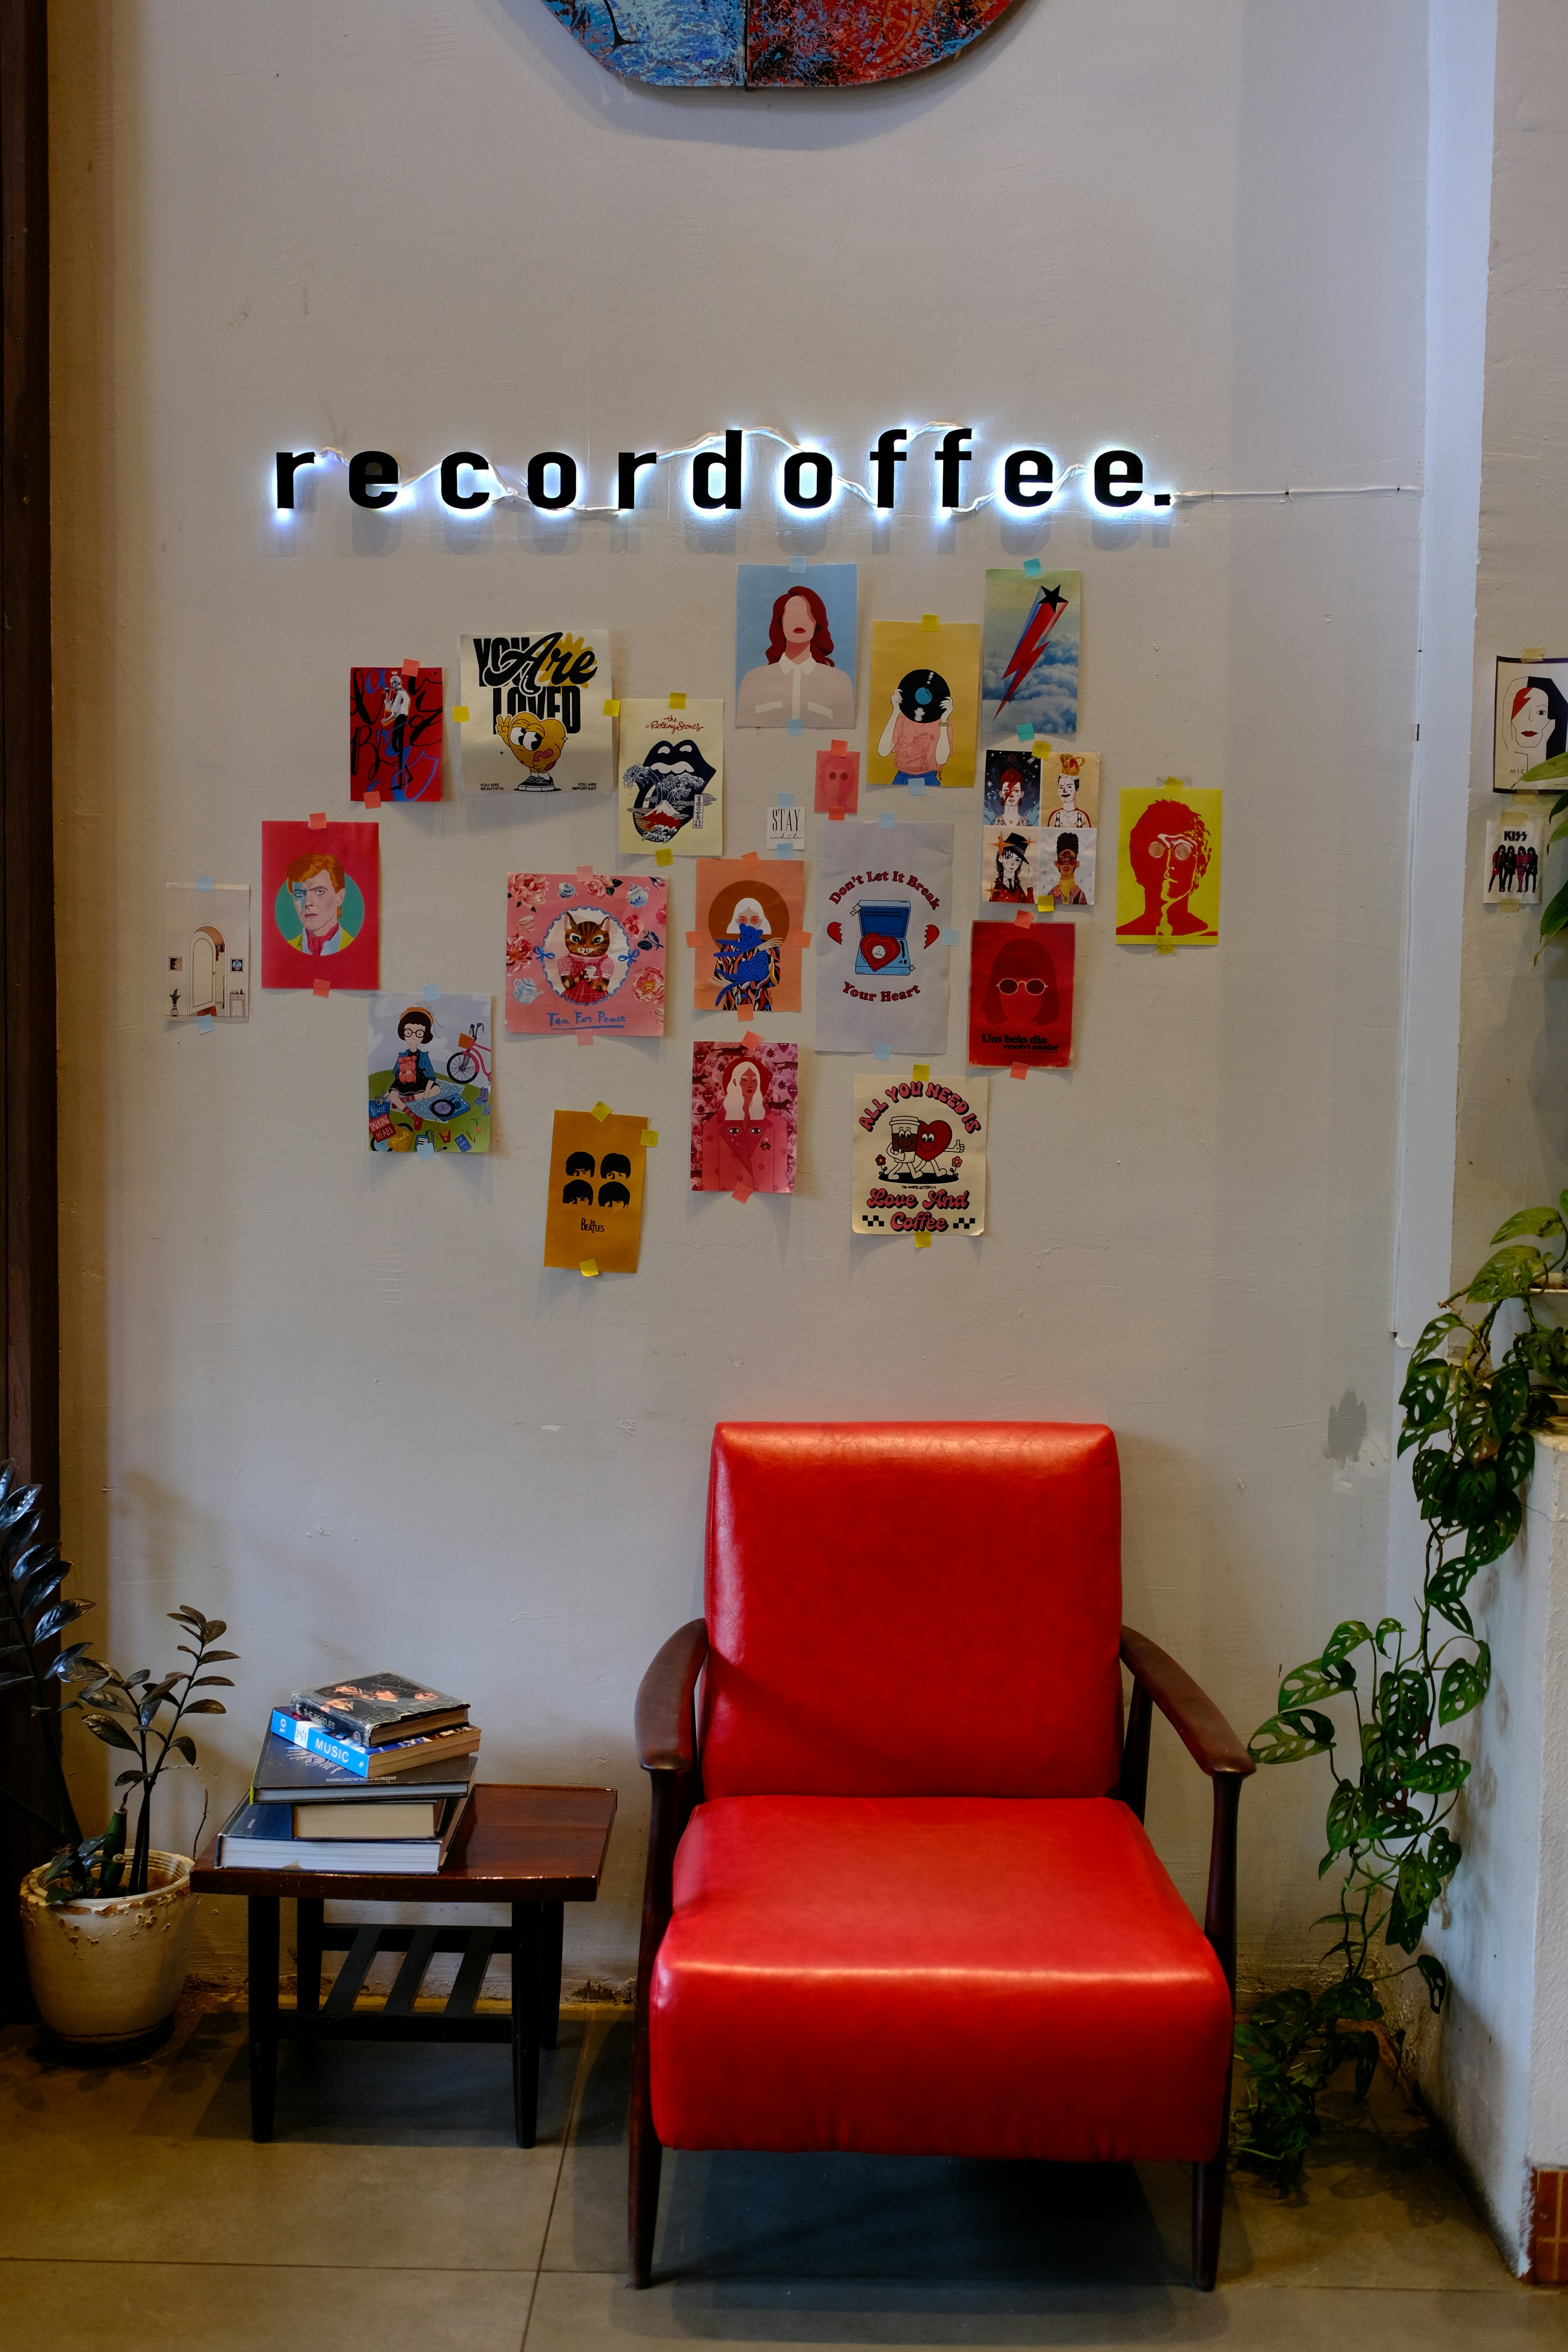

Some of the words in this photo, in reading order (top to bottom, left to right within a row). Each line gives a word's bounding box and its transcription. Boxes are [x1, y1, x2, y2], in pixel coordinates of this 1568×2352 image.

[484, 632, 597, 694] Are
[645, 721, 676, 734] Rolling
[677, 721, 704, 731] Stones
[773, 809, 801, 831] STAY
[1504, 831, 1527, 841] KISS
[829, 875, 864, 905] Don't
[866, 871, 889, 882] Let
[893, 871, 905, 883] It
[906, 875, 940, 911] Break
[842, 981, 876, 1001] Your
[880, 984, 921, 1002] Heart
[547, 1012, 570, 1026] Tea
[574, 1011, 592, 1024] For
[597, 1011, 626, 1024] Peace
[982, 1034, 1002, 1043] Um
[1004, 1034, 1027, 1043] belo
[1029, 1035, 1047, 1044] dia
[371, 1106, 386, 1116] BOWIE
[859, 1099, 889, 1132] ALL
[885, 1081, 924, 1103] YOU
[925, 1082, 969, 1115] NEED
[961, 1113, 982, 1134] IS
[369, 1116, 389, 1131] TALKING
[375, 1126, 393, 1140] HEADS
[390, 1131, 410, 1146] Blondie
[867, 1188, 919, 1209] Love
[922, 1189, 970, 1210] And
[890, 1211, 949, 1232] Coffee
[280, 1718, 286, 1733] 10
[303, 1708, 313, 1718] THE
[313, 1713, 335, 1730] BEATLES
[315, 1738, 349, 1762] MUSIC
